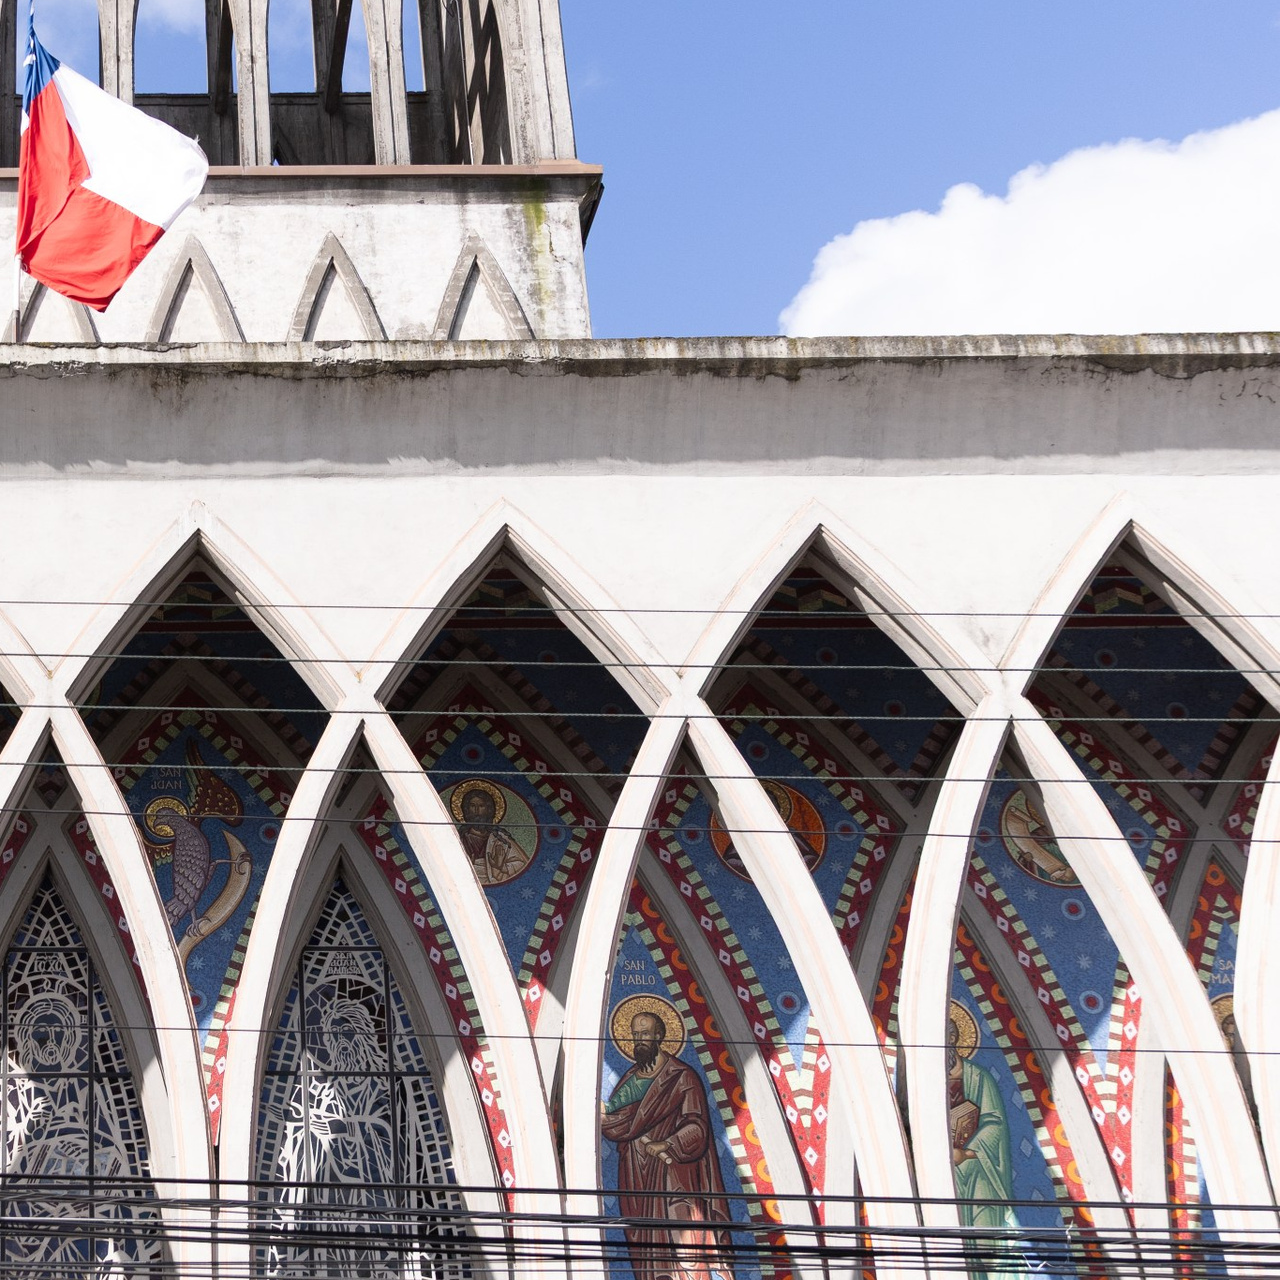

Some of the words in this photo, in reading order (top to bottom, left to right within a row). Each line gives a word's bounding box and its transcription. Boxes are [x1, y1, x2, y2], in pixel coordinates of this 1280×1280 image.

[160, 767, 181, 777] SAN
[151, 781, 182, 790] JUAN
[624, 960, 646, 971] SAN
[1219, 959, 1236, 971] SA
[621, 974, 656, 986] PABLO
